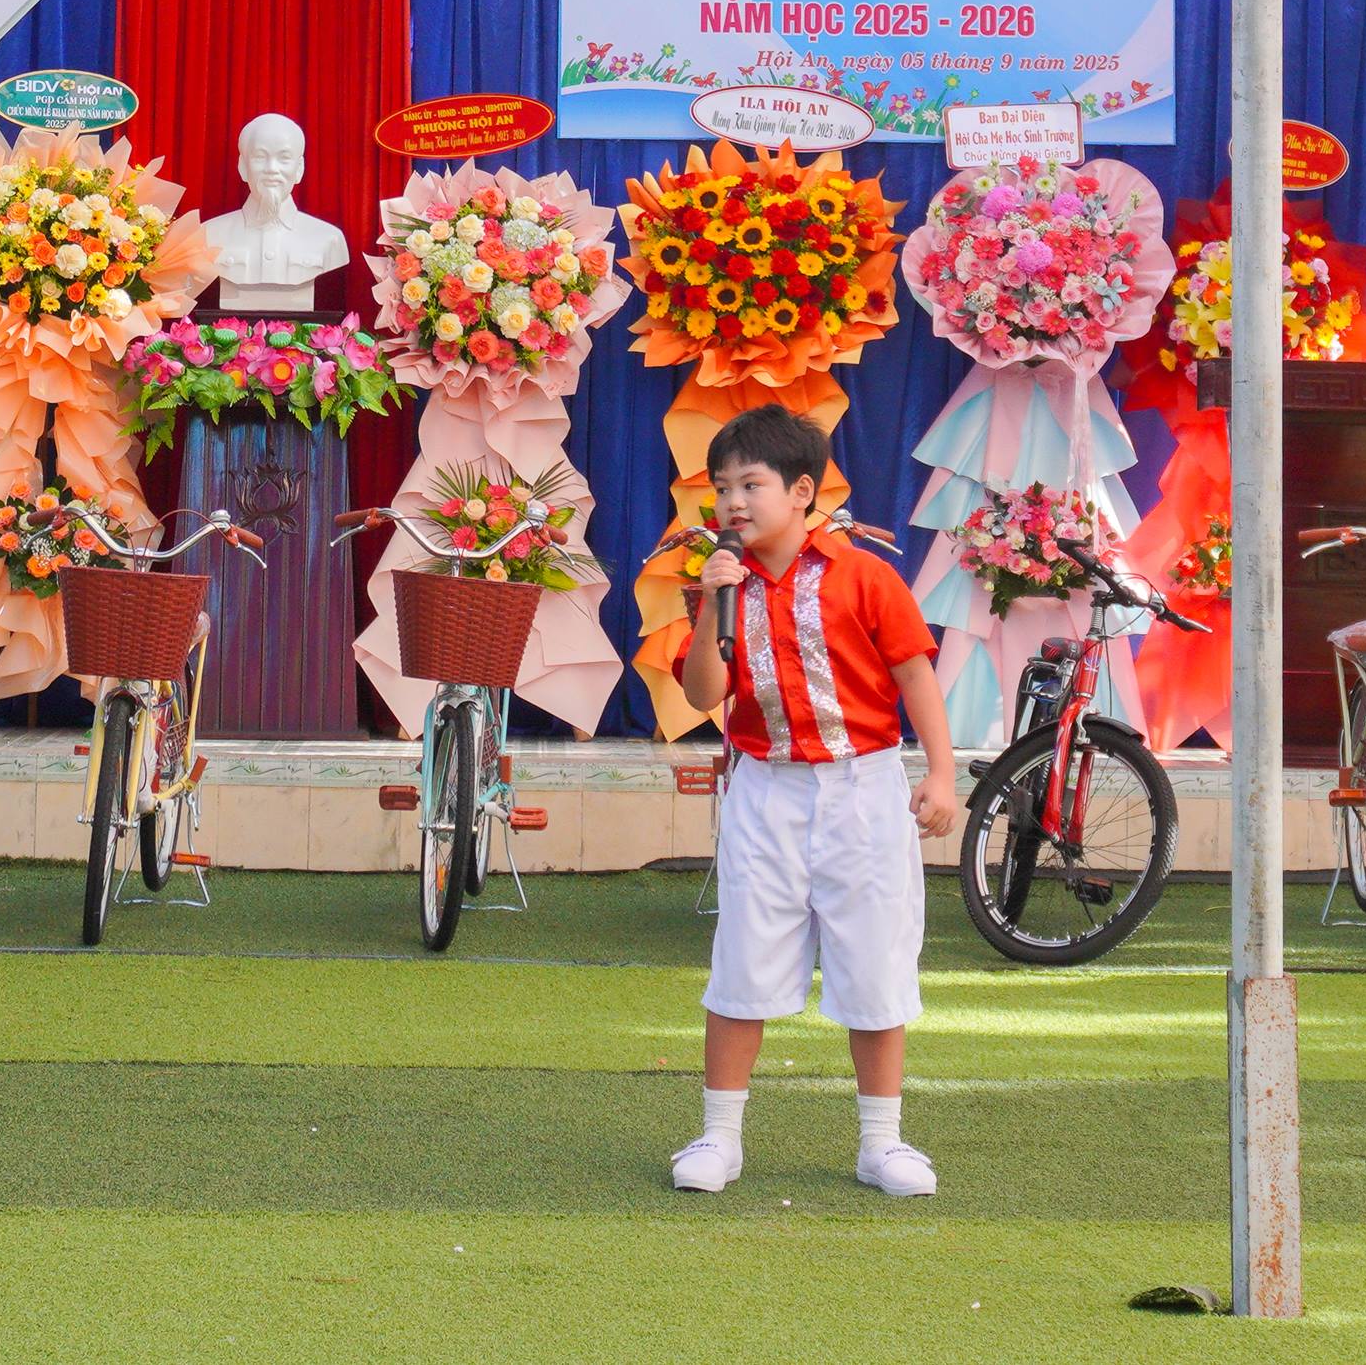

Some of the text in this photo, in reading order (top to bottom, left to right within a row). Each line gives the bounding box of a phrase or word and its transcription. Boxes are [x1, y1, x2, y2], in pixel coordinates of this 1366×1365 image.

[783, 2, 844, 42] HỌC
[853, 4, 929, 35] 2025
[961, 5, 1035, 36] 2026
[755, 50, 1120, 73] Hội An, ngày 05 tháng 9 năm 2025
[15, 80, 123, 96] BIDV HỘI AN
[35, 95, 54, 104] PGD
[740, 96, 829, 116] ILA HỘI AN
[45, 119, 86, 129] 2025-26
[413, 114, 514, 135] PHƯỜNG HỘI AN
[979, 109, 1045, 126] Ban Đại Diện
[972, 131, 988, 145] Cha
[991, 131, 1003, 147] Mẹ
[1005, 130, 1022, 146] Học
[1024, 129, 1043, 143] Sinh
